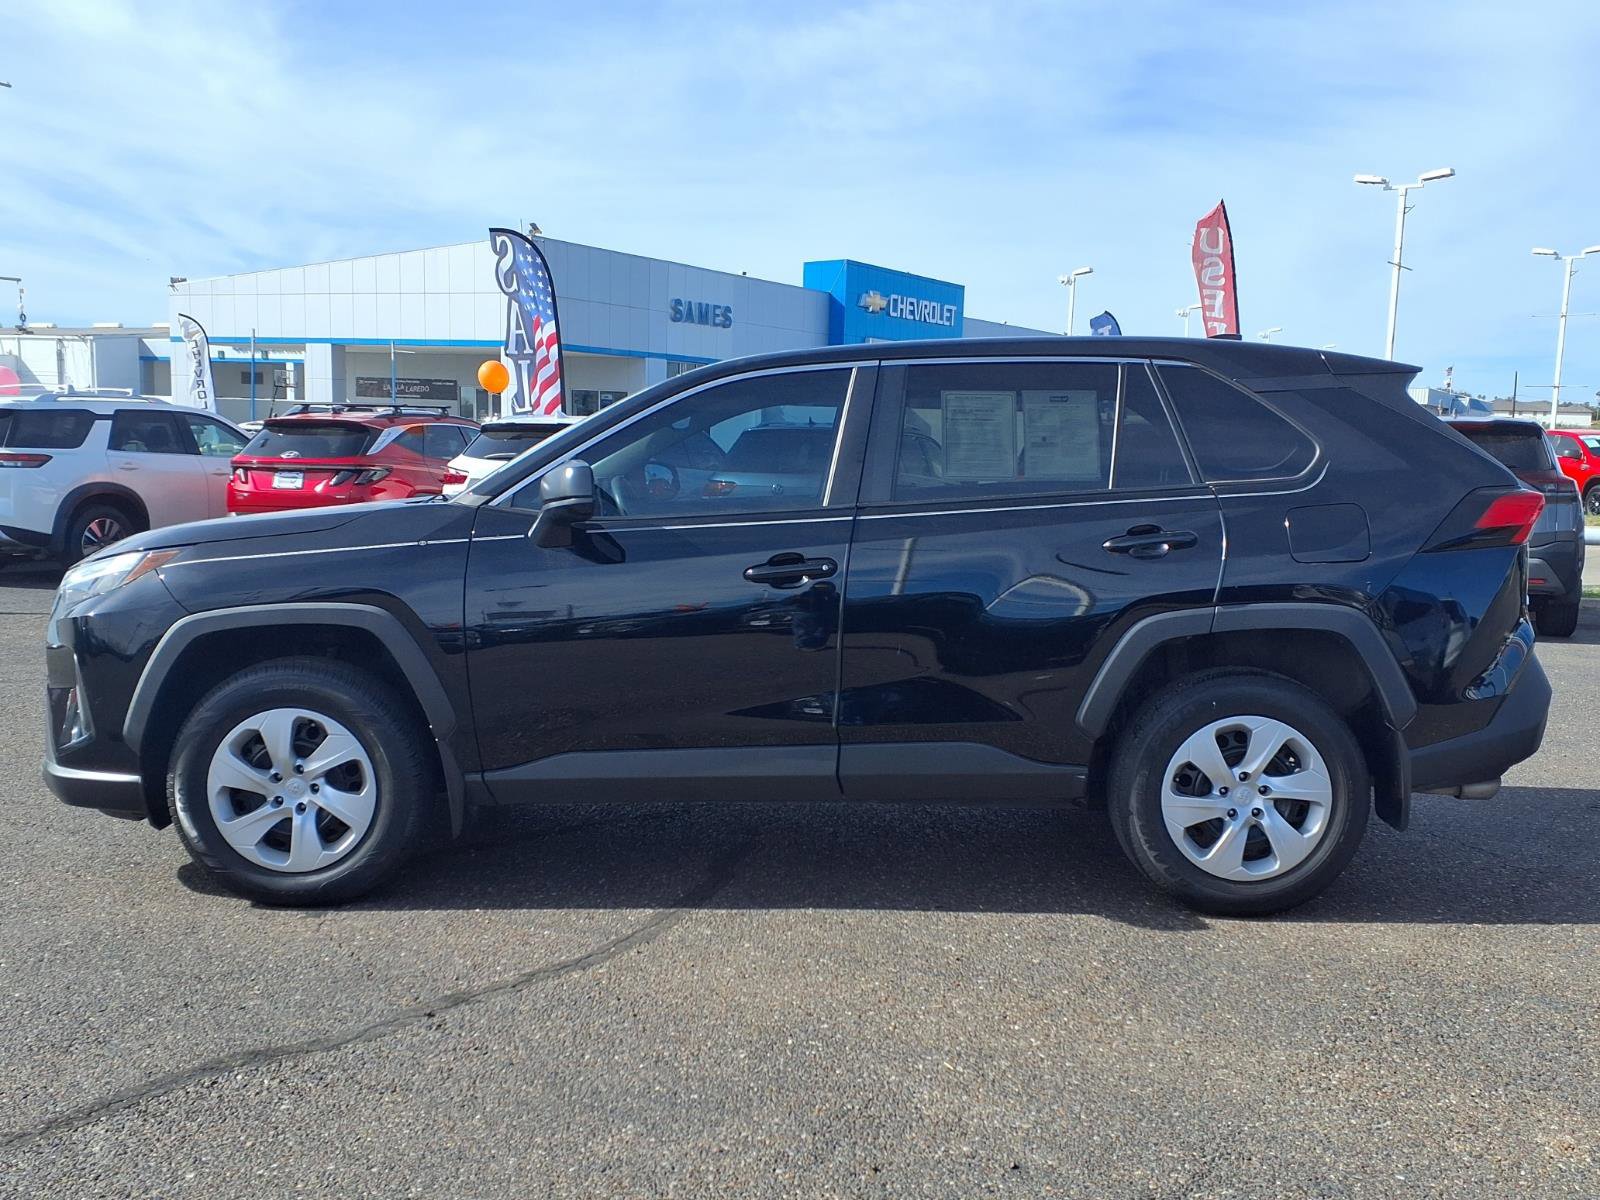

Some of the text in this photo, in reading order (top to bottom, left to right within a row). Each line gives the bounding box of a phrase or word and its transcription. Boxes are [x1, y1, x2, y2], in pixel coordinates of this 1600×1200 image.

[671, 298, 733, 328] SAMES
[889, 294, 957, 327] CHEVROLET
[405, 385, 430, 393] LAREDO
